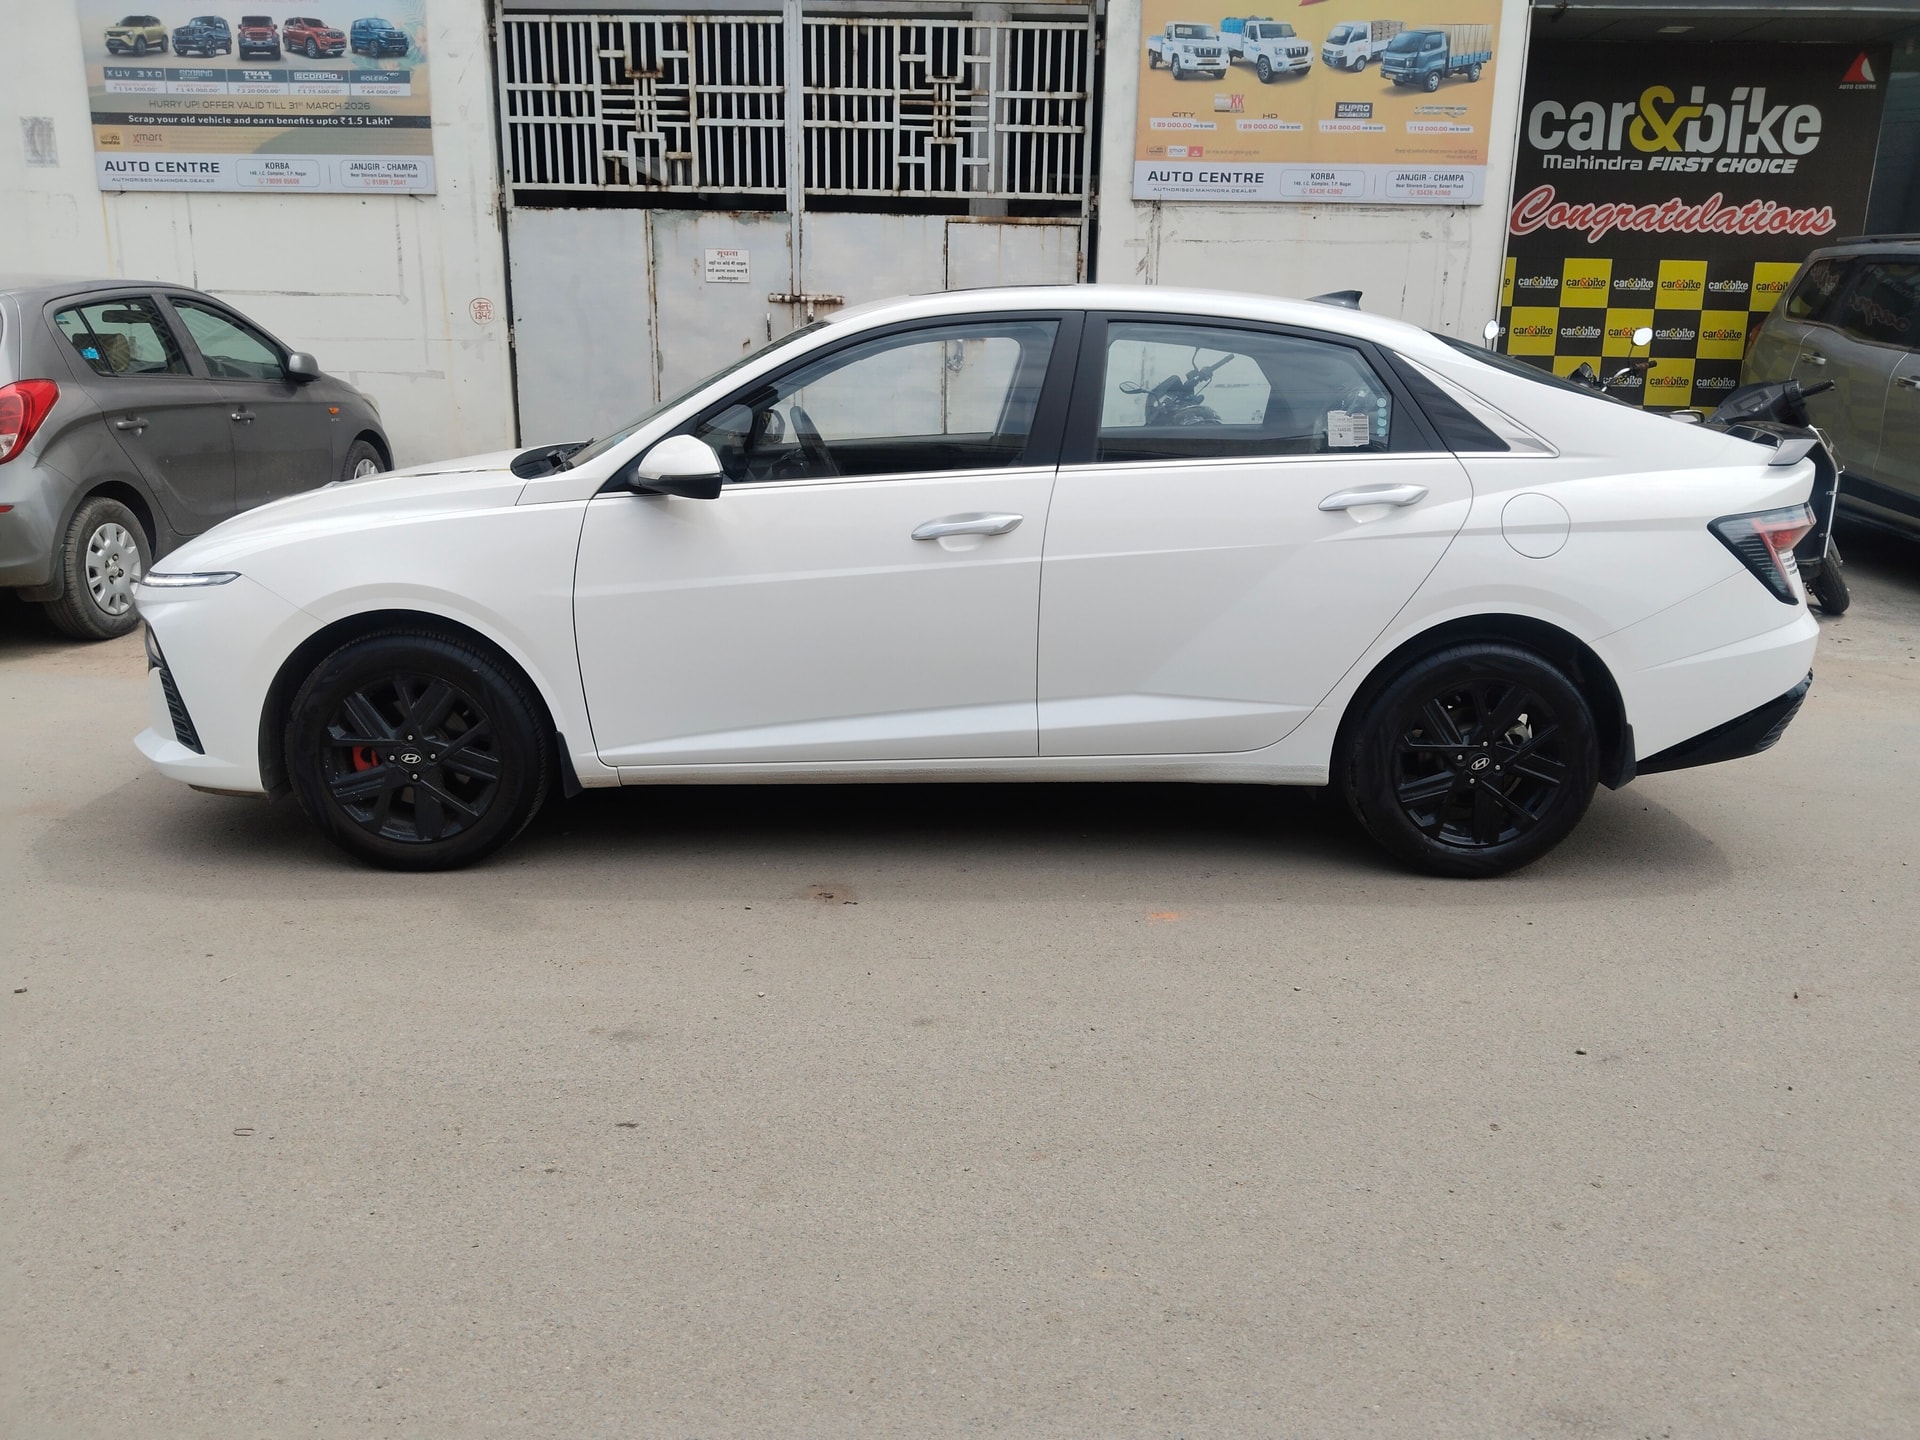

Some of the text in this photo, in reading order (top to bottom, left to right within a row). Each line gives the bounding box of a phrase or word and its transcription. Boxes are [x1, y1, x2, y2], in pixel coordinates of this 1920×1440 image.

[238, 101, 264, 109] VALID
[128, 115, 154, 124] Scrap
[198, 116, 231, 124] vehicle
[276, 117, 314, 125] benefits
[317, 118, 338, 128] upto
[1528, 85, 1822, 156] car&bike
[105, 161, 220, 173] AUTO CENTRE
[1543, 154, 1798, 174] Mahindra FIRST CHOICE
[1148, 171, 1264, 183] AUTO CENTRE
[1510, 184, 1836, 243] Congratulations
[1518, 276, 1559, 286] car&bike
[1566, 277, 1606, 287] car&bike
[1614, 278, 1654, 288] car&bike
[1661, 279, 1701, 289] car&bike
[1708, 280, 1748, 290] car&bike
[1514, 326, 1553, 335] car&bike
[1561, 326, 1601, 336] car&bike
[1656, 328, 1695, 338] car&bike
[1703, 329, 1742, 339] car&bike
[1650, 376, 1689, 386] car&bike
[1696, 378, 1736, 387] car&bike
